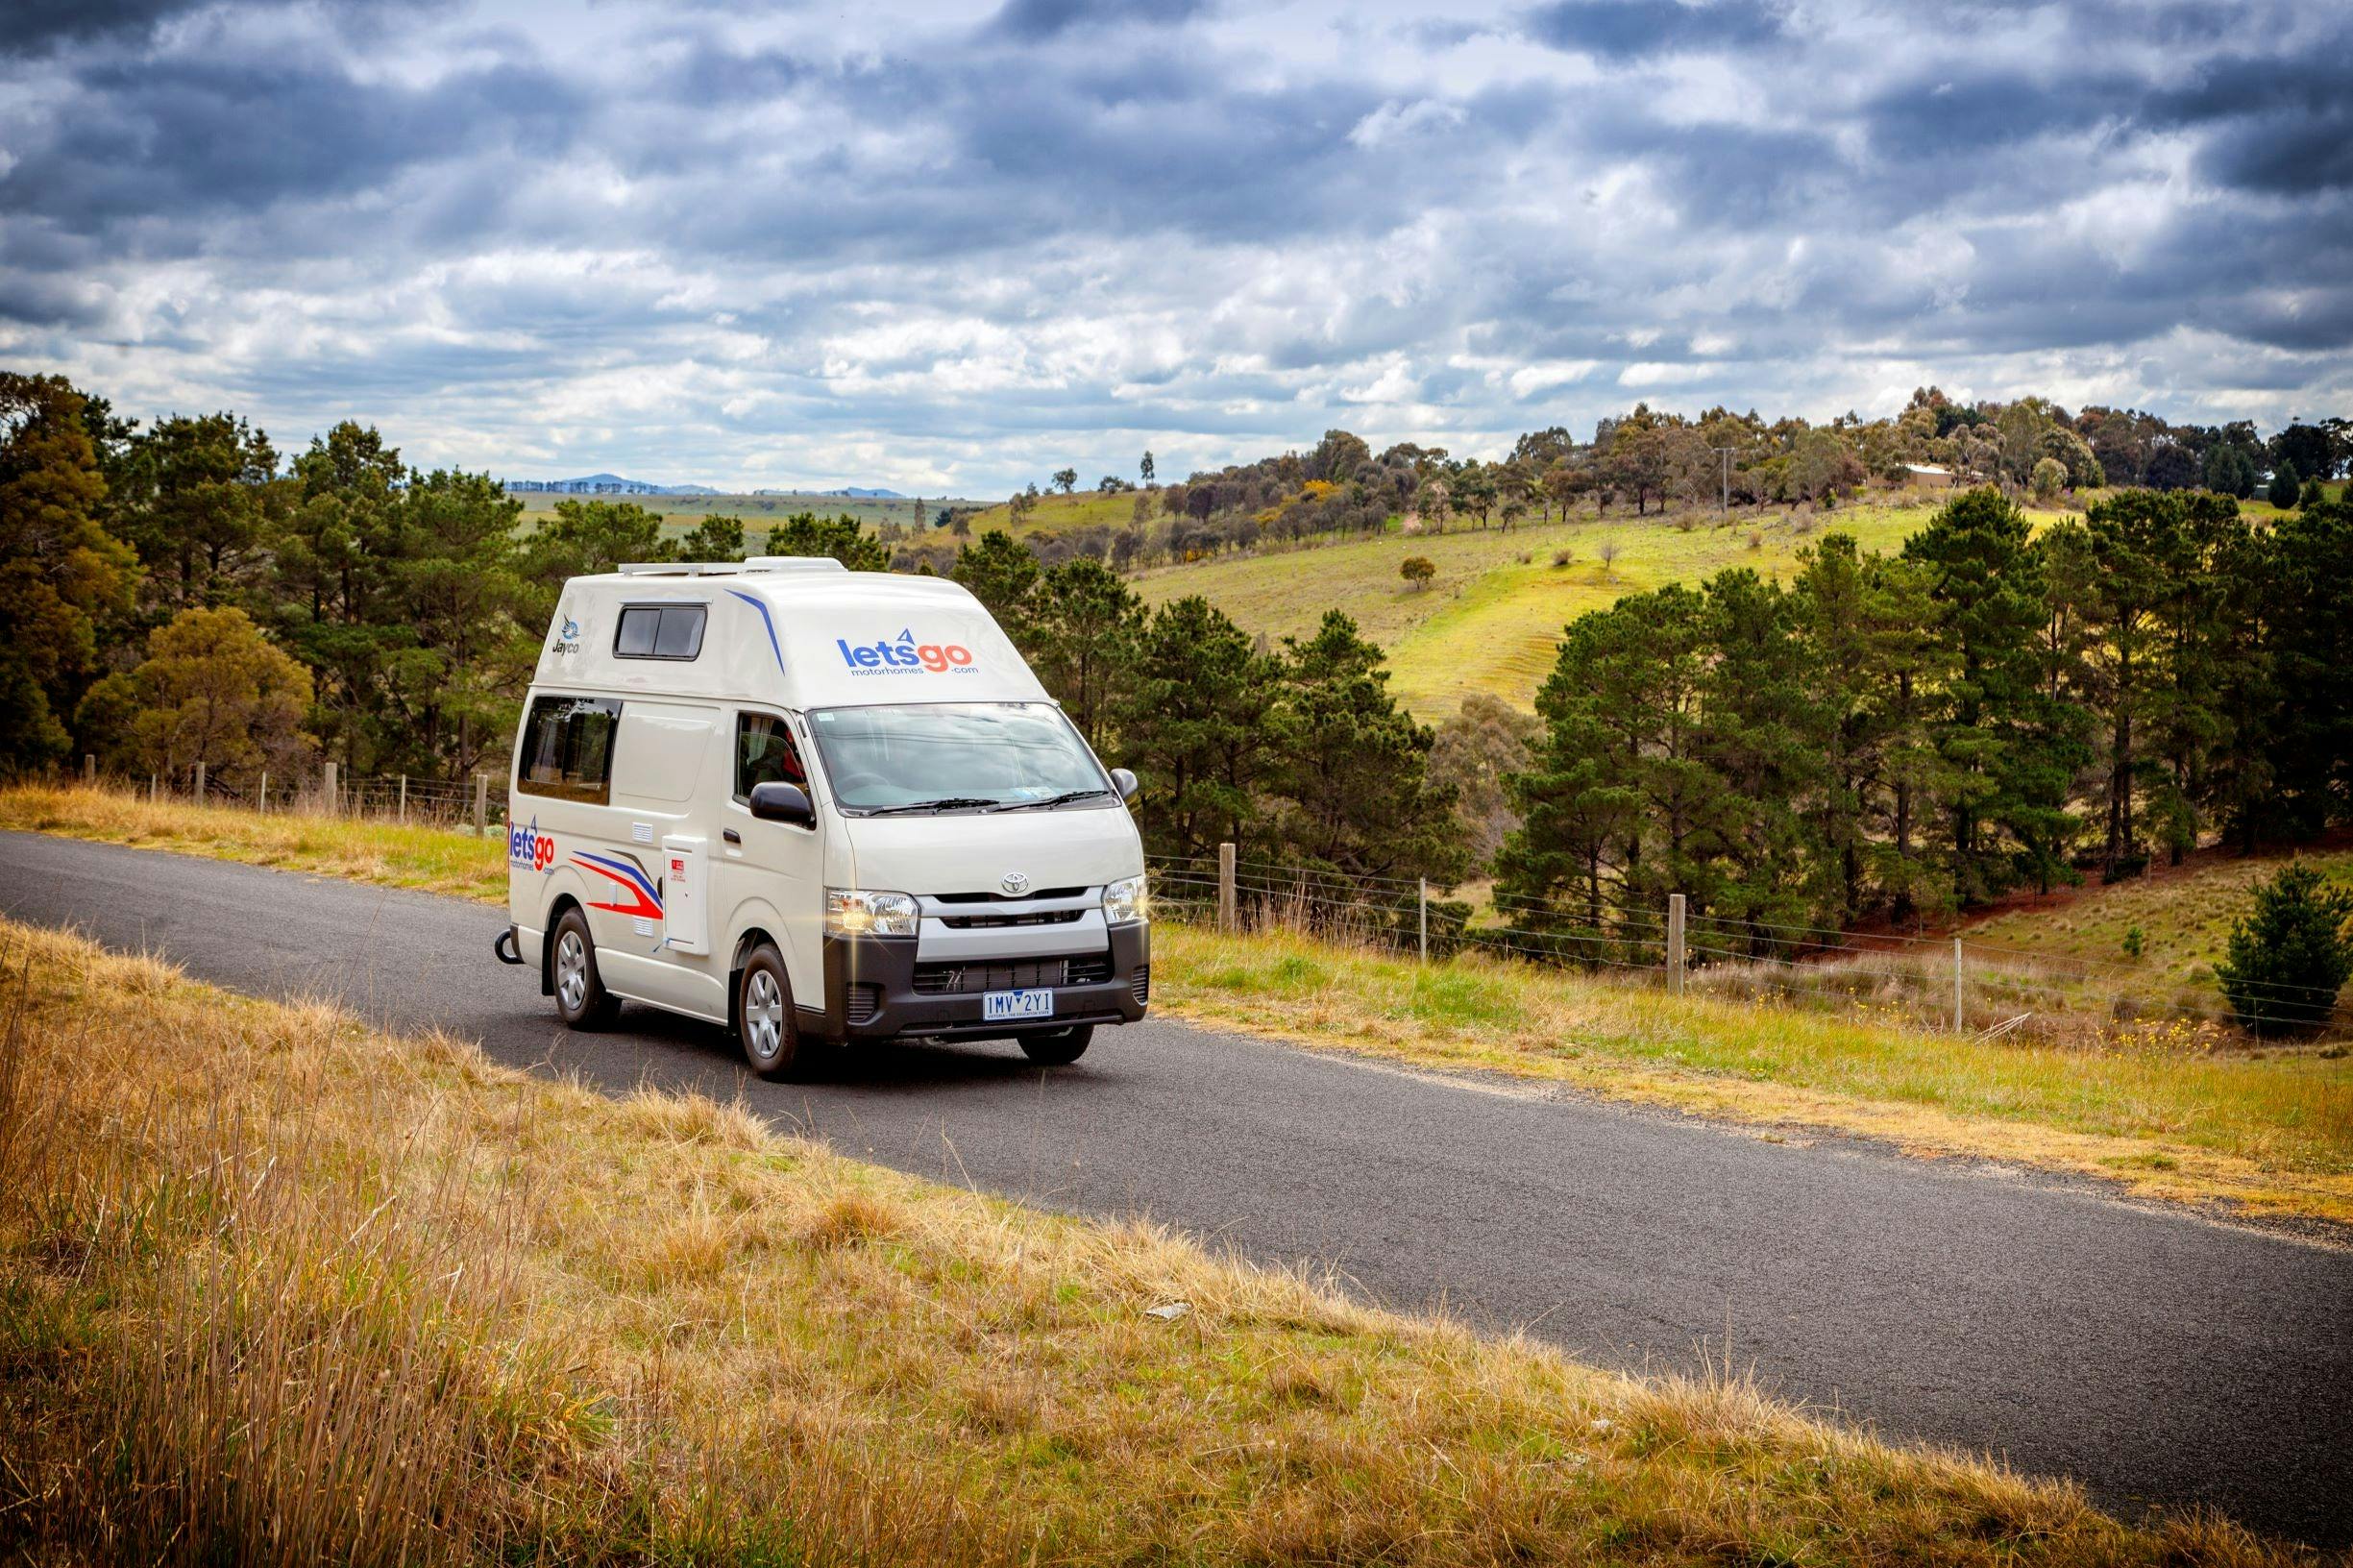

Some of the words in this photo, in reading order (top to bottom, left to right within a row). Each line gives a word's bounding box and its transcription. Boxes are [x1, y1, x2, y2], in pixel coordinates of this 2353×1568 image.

[551, 638, 579, 656] Jayco
[851, 667, 924, 676] motorhomes
[988, 995, 1013, 1014] 1MV
